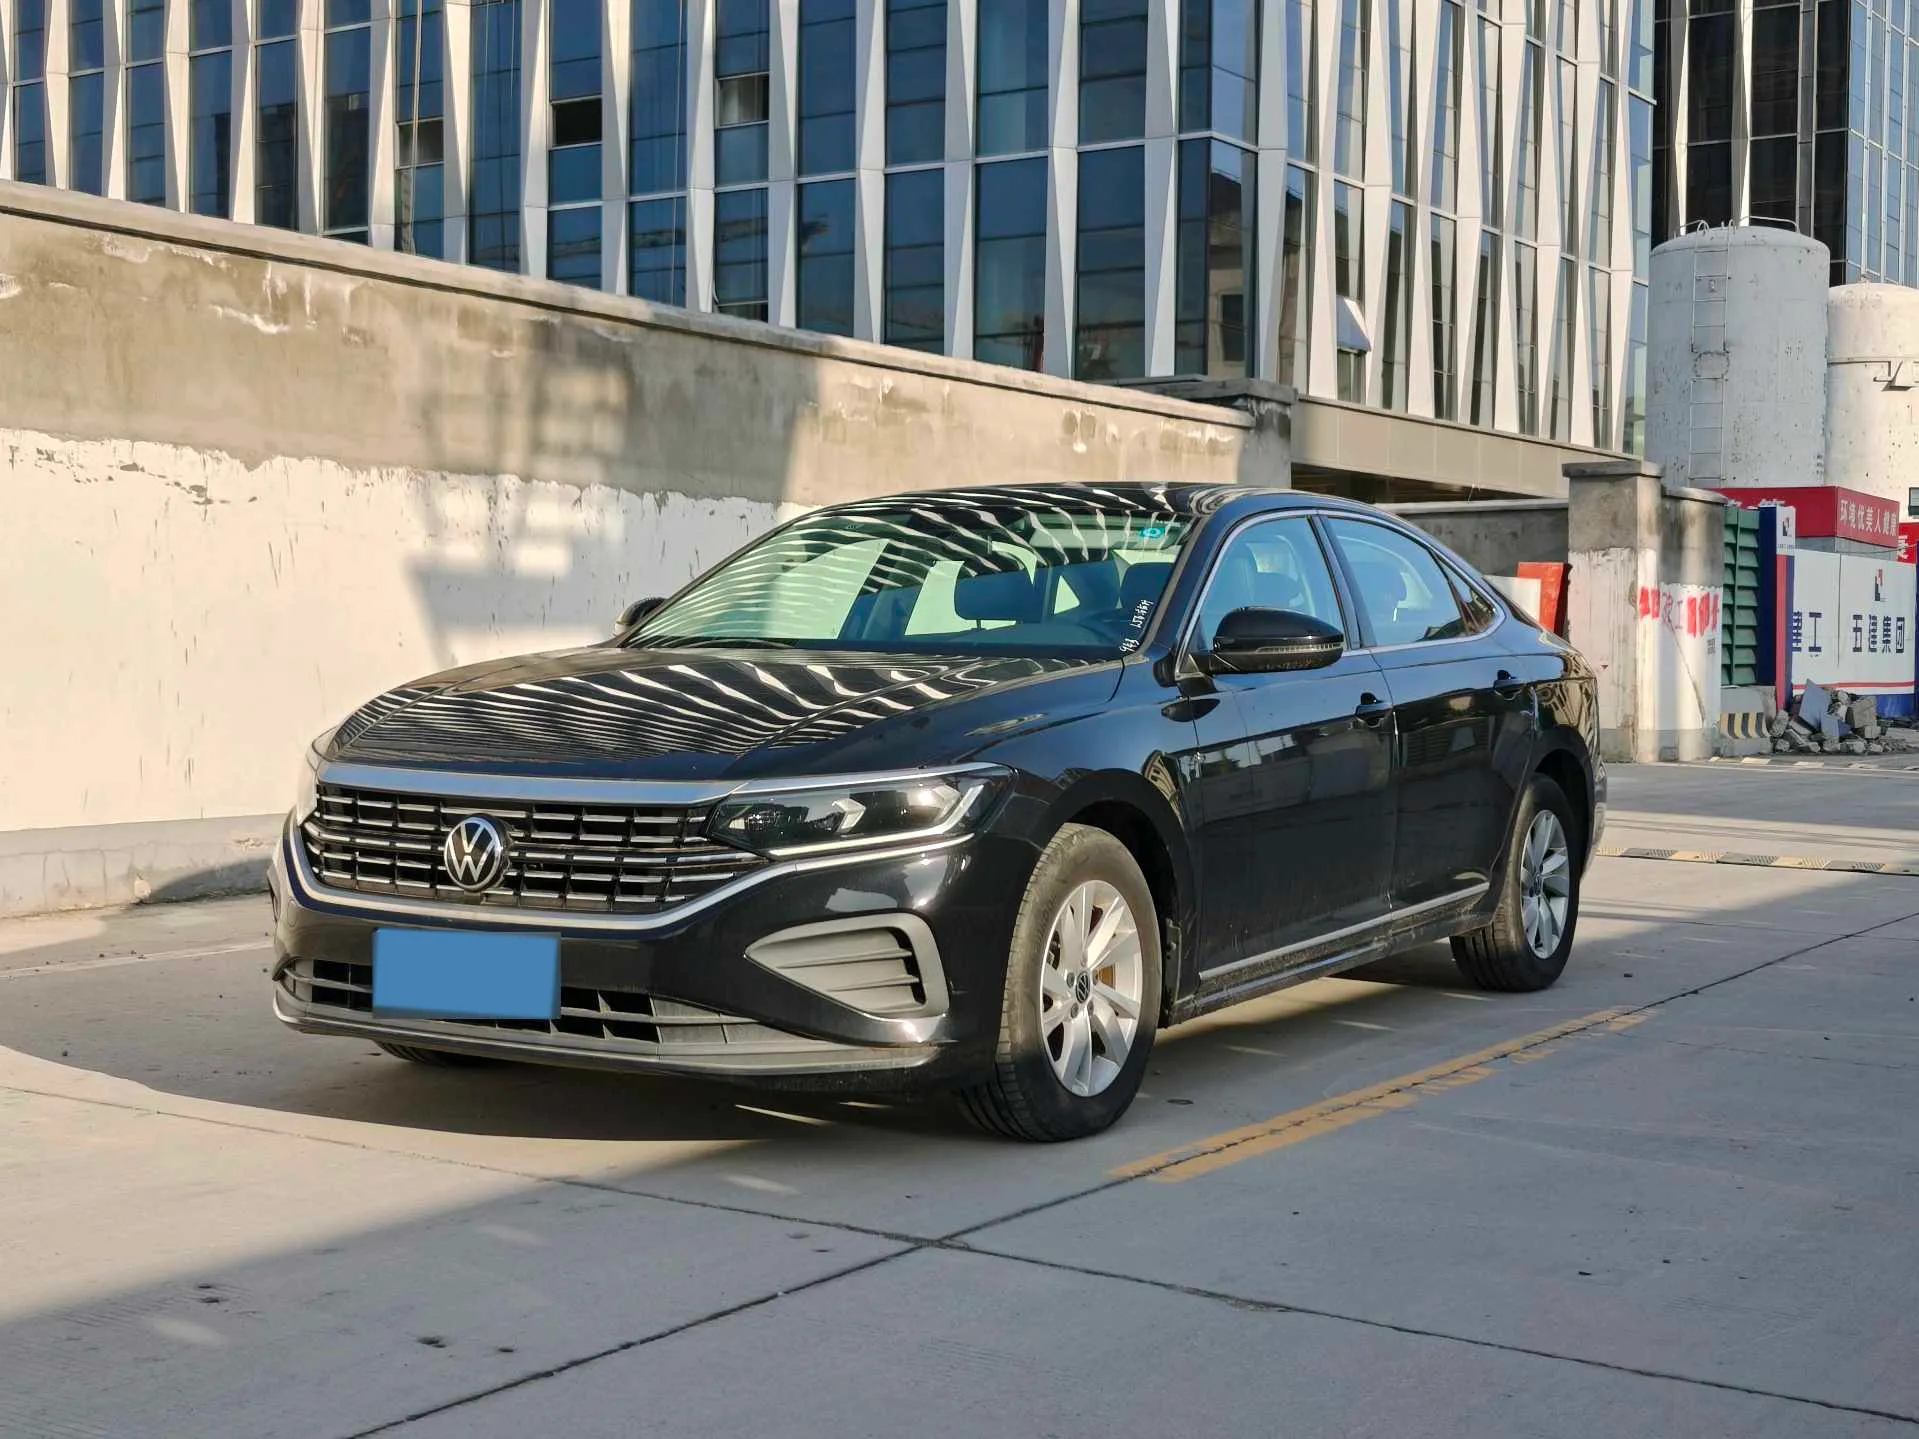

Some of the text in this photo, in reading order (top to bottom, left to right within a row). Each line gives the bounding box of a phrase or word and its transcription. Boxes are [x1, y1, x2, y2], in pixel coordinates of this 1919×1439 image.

[1840, 499, 1897, 537] 环境优美人健康
[1852, 614, 1905, 654] 五建集团
[446, 817, 499, 887] VW
